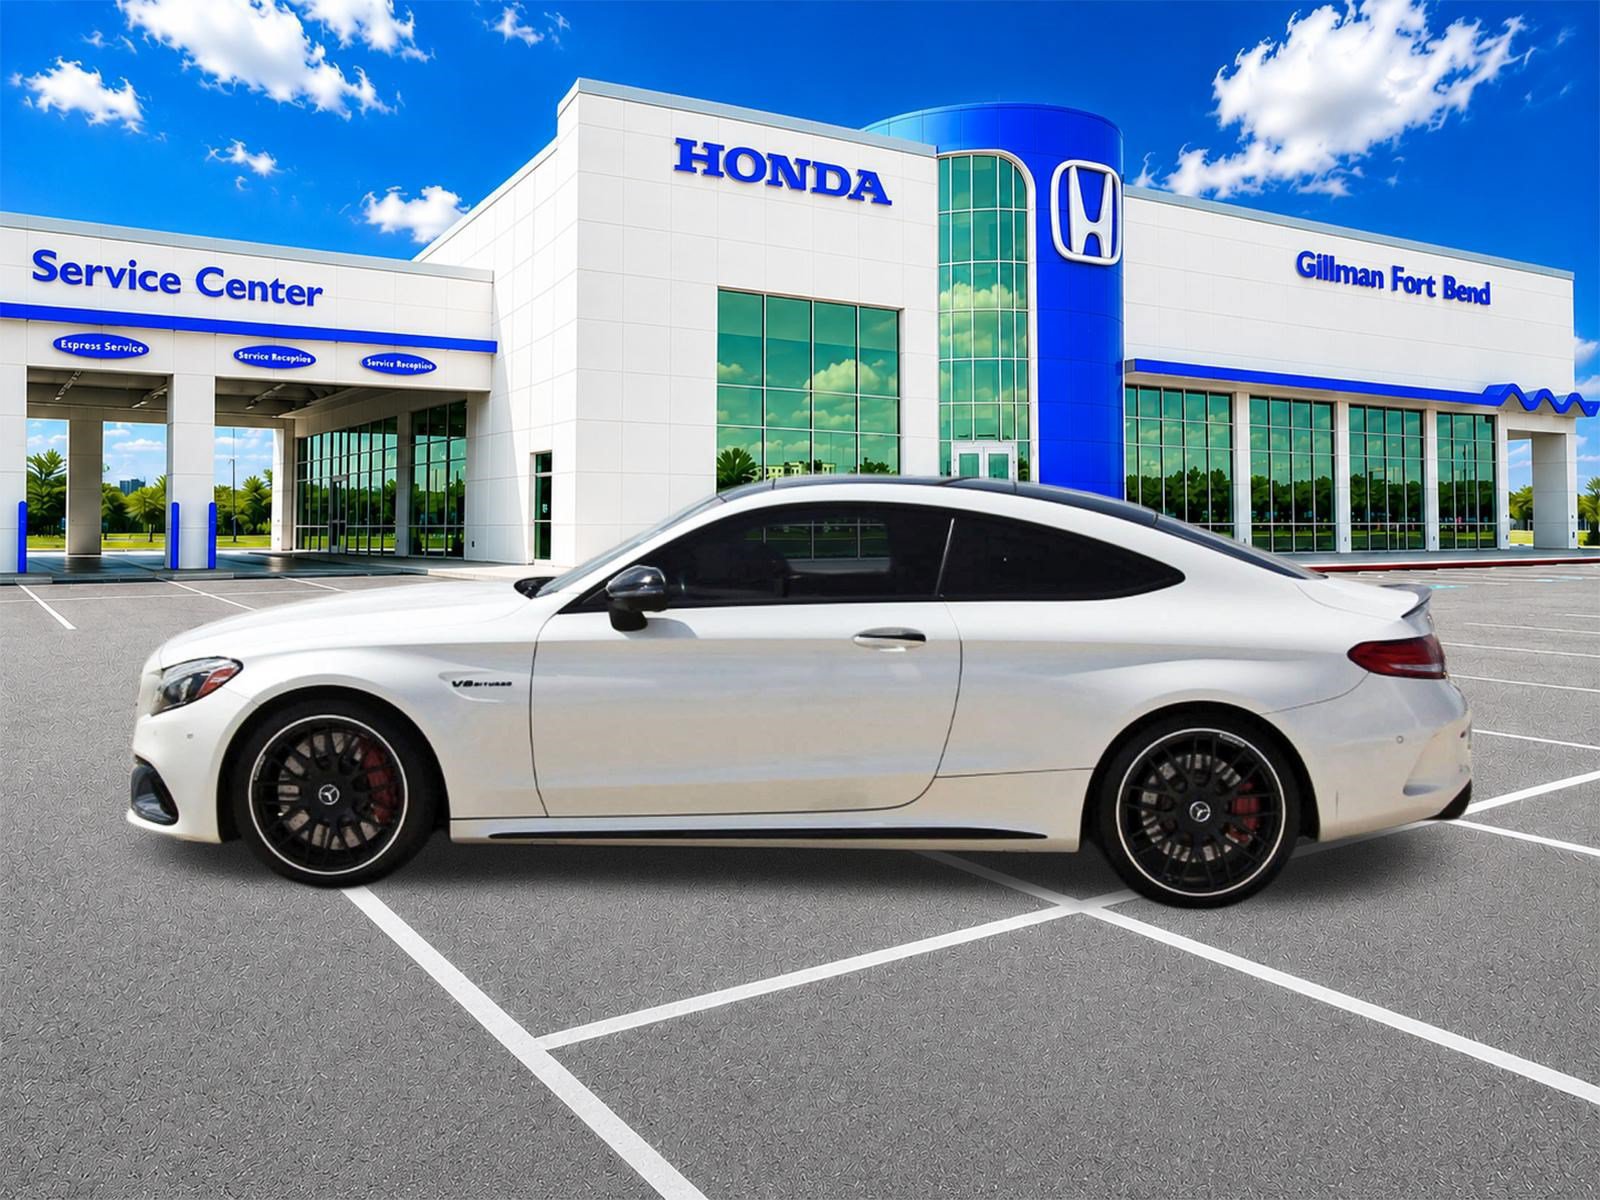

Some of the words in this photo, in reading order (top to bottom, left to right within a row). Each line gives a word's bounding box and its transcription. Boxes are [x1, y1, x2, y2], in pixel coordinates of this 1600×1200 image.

[673, 137, 892, 206] HONDA
[32, 249, 182, 294] Service
[195, 266, 324, 307] Center
[1296, 250, 1385, 289] Gillman
[1391, 265, 1436, 298] Fort
[1443, 275, 1491, 305] Bend
[104, 342, 144, 354] Service
[238, 351, 270, 361] Service
[366, 358, 395, 368] Service
